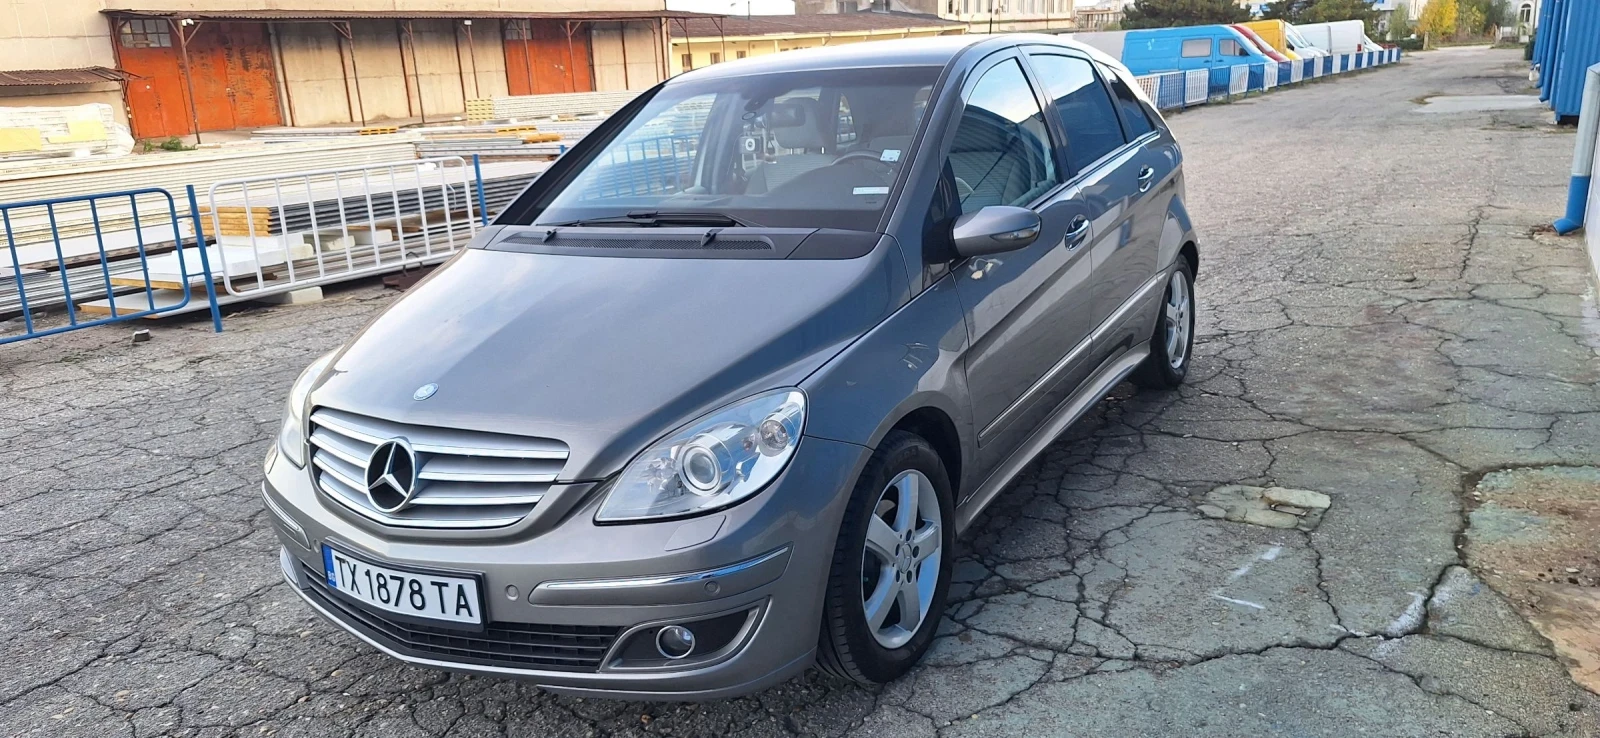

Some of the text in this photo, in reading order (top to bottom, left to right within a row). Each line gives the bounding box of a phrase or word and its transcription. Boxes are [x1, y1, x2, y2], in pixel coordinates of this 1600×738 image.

[335, 555, 473, 616] TX 1878 TA
